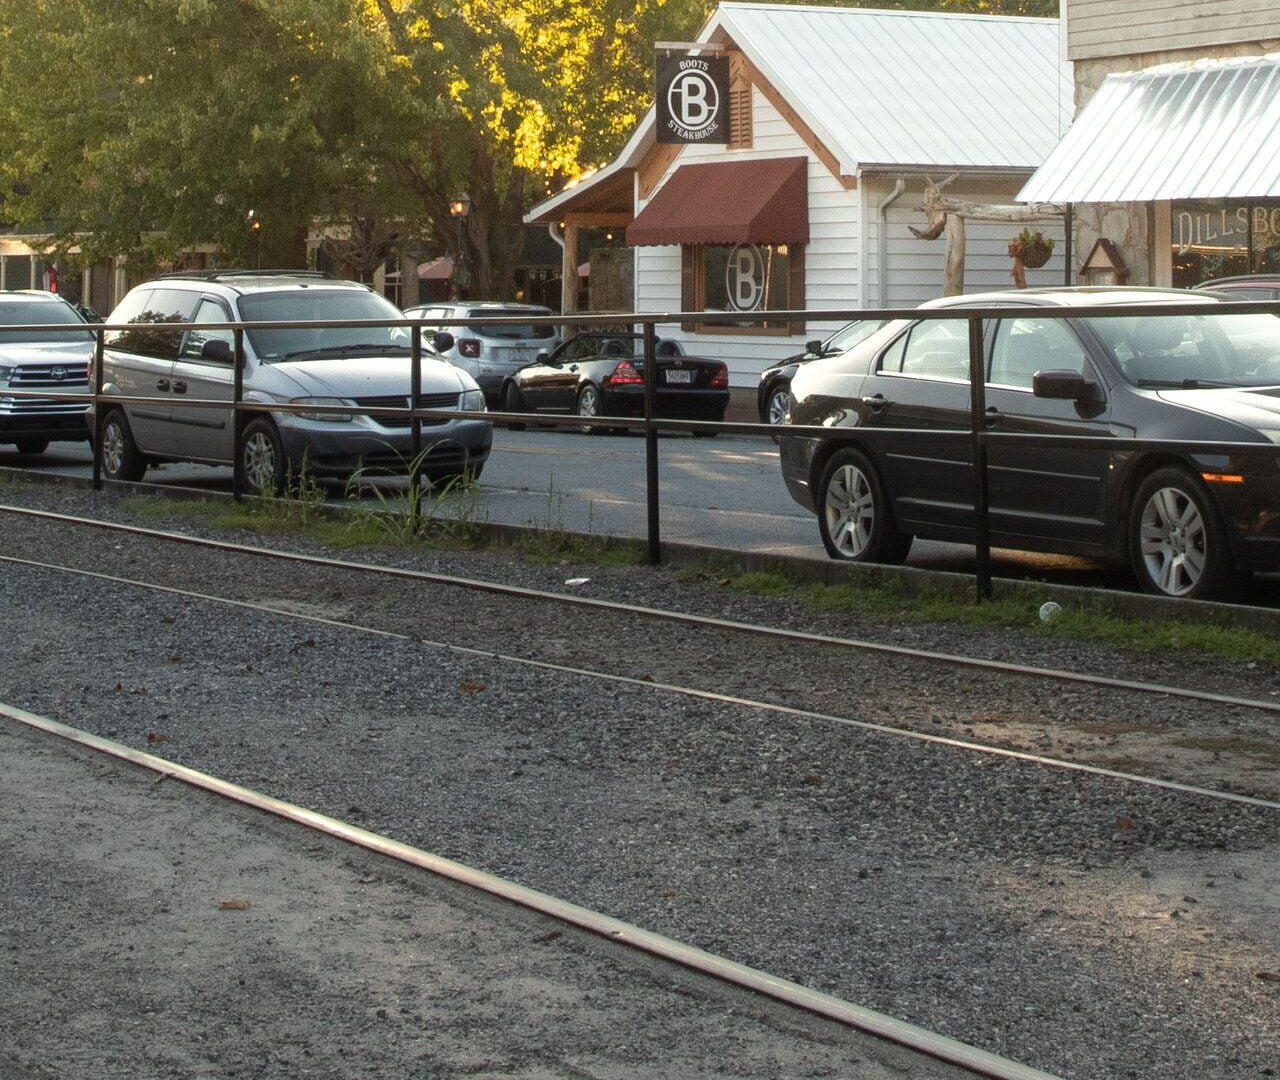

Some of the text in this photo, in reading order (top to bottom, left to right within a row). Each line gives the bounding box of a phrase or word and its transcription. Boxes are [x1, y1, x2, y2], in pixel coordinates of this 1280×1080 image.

[679, 60, 709, 71] BOOTS
[681, 76, 709, 125] B
[668, 120, 718, 139] STEAKHOUSE
